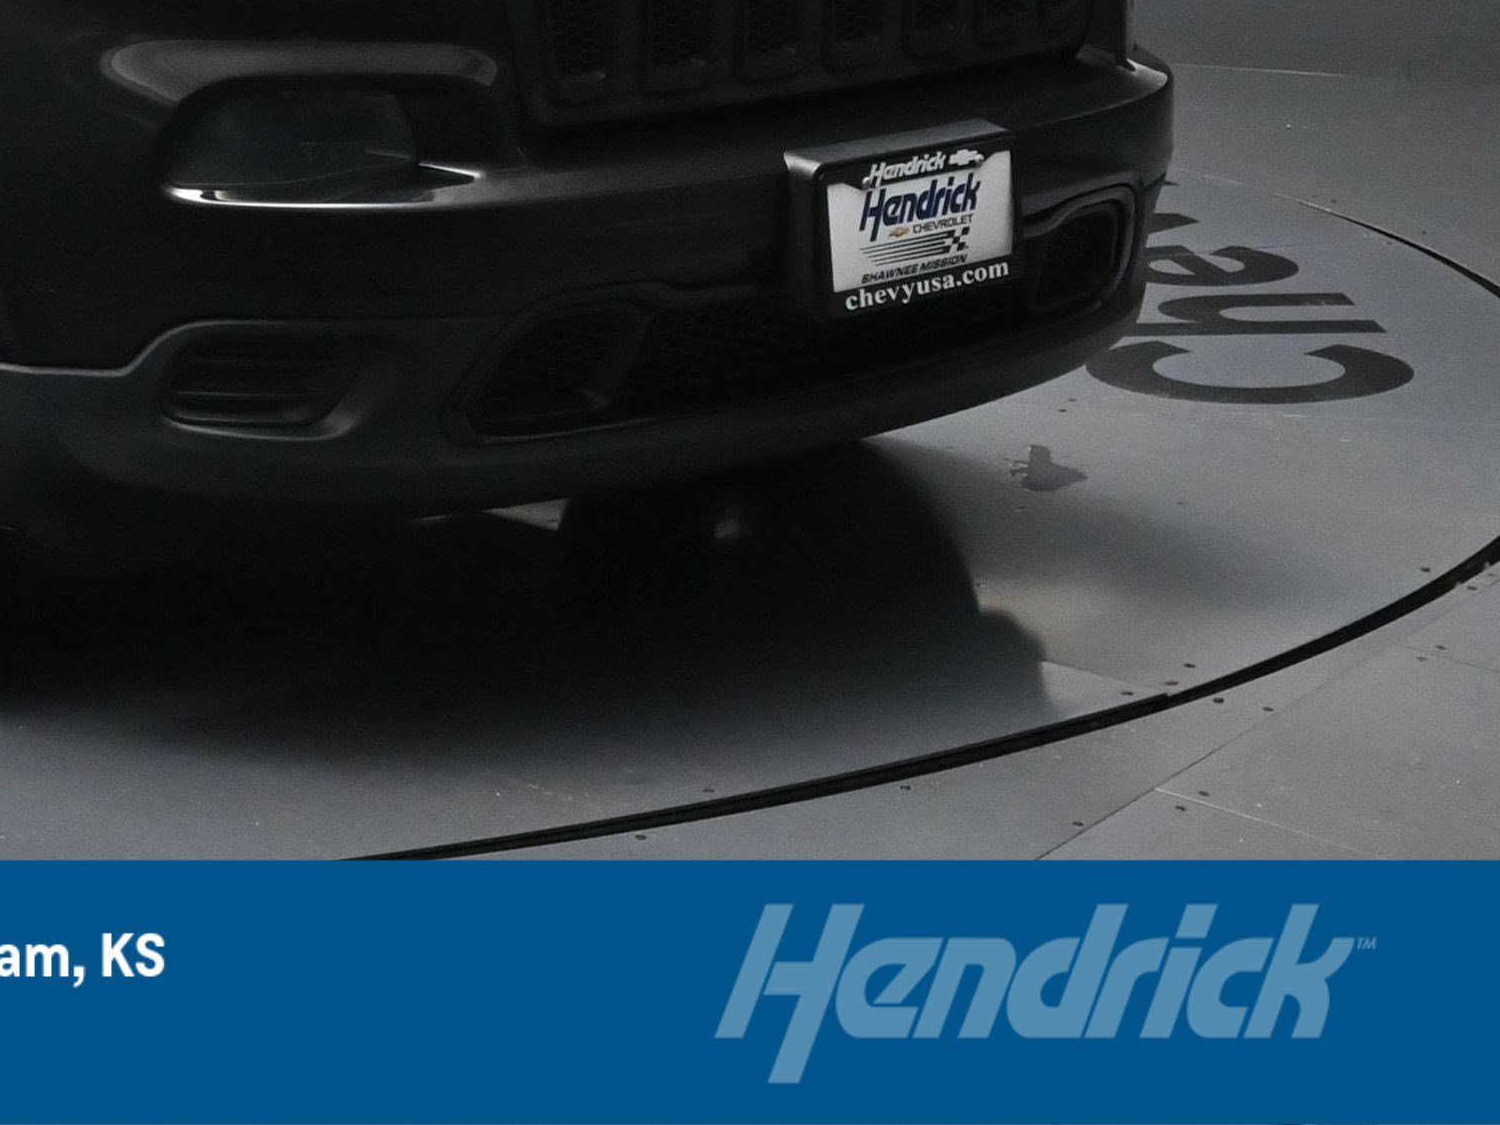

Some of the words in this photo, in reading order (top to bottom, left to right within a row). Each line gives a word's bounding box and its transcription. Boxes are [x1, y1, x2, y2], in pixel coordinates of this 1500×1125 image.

[869, 150, 946, 188] Hendrick
[859, 172, 982, 242] Hendrick
[912, 214, 975, 234] CHEVROLET
[845, 261, 1010, 310] chevyusa.com
[861, 262, 920, 284] SHAWNEE
[920, 254, 969, 272] MISSION
